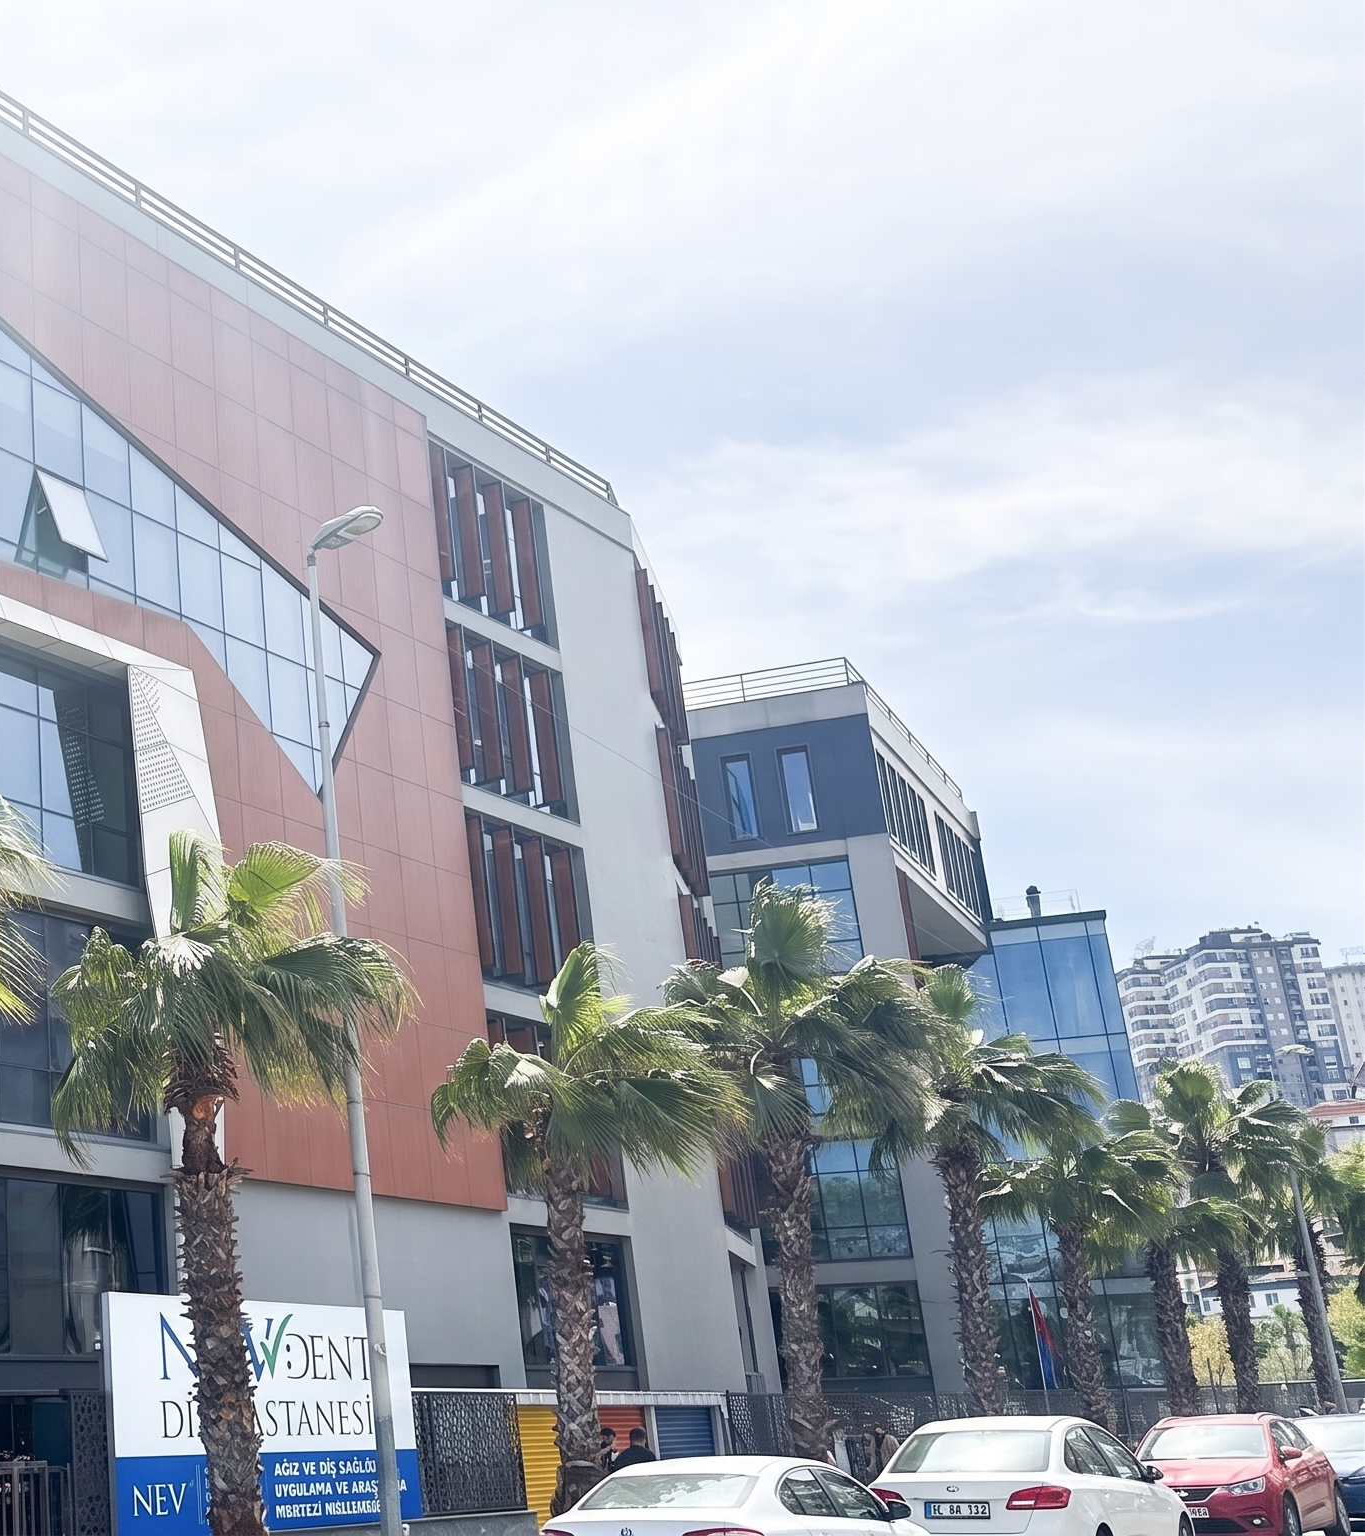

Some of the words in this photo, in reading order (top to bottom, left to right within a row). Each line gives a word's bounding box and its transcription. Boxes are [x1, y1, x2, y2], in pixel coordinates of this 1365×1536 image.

[159, 1391, 197, 1438] Dİ
[251, 1394, 374, 1437] STANESİ
[302, 1461, 316, 1476] VE
[133, 1483, 187, 1517] NEV
[275, 1482, 333, 1497] UYGULAMA
[335, 1481, 349, 1495] VE
